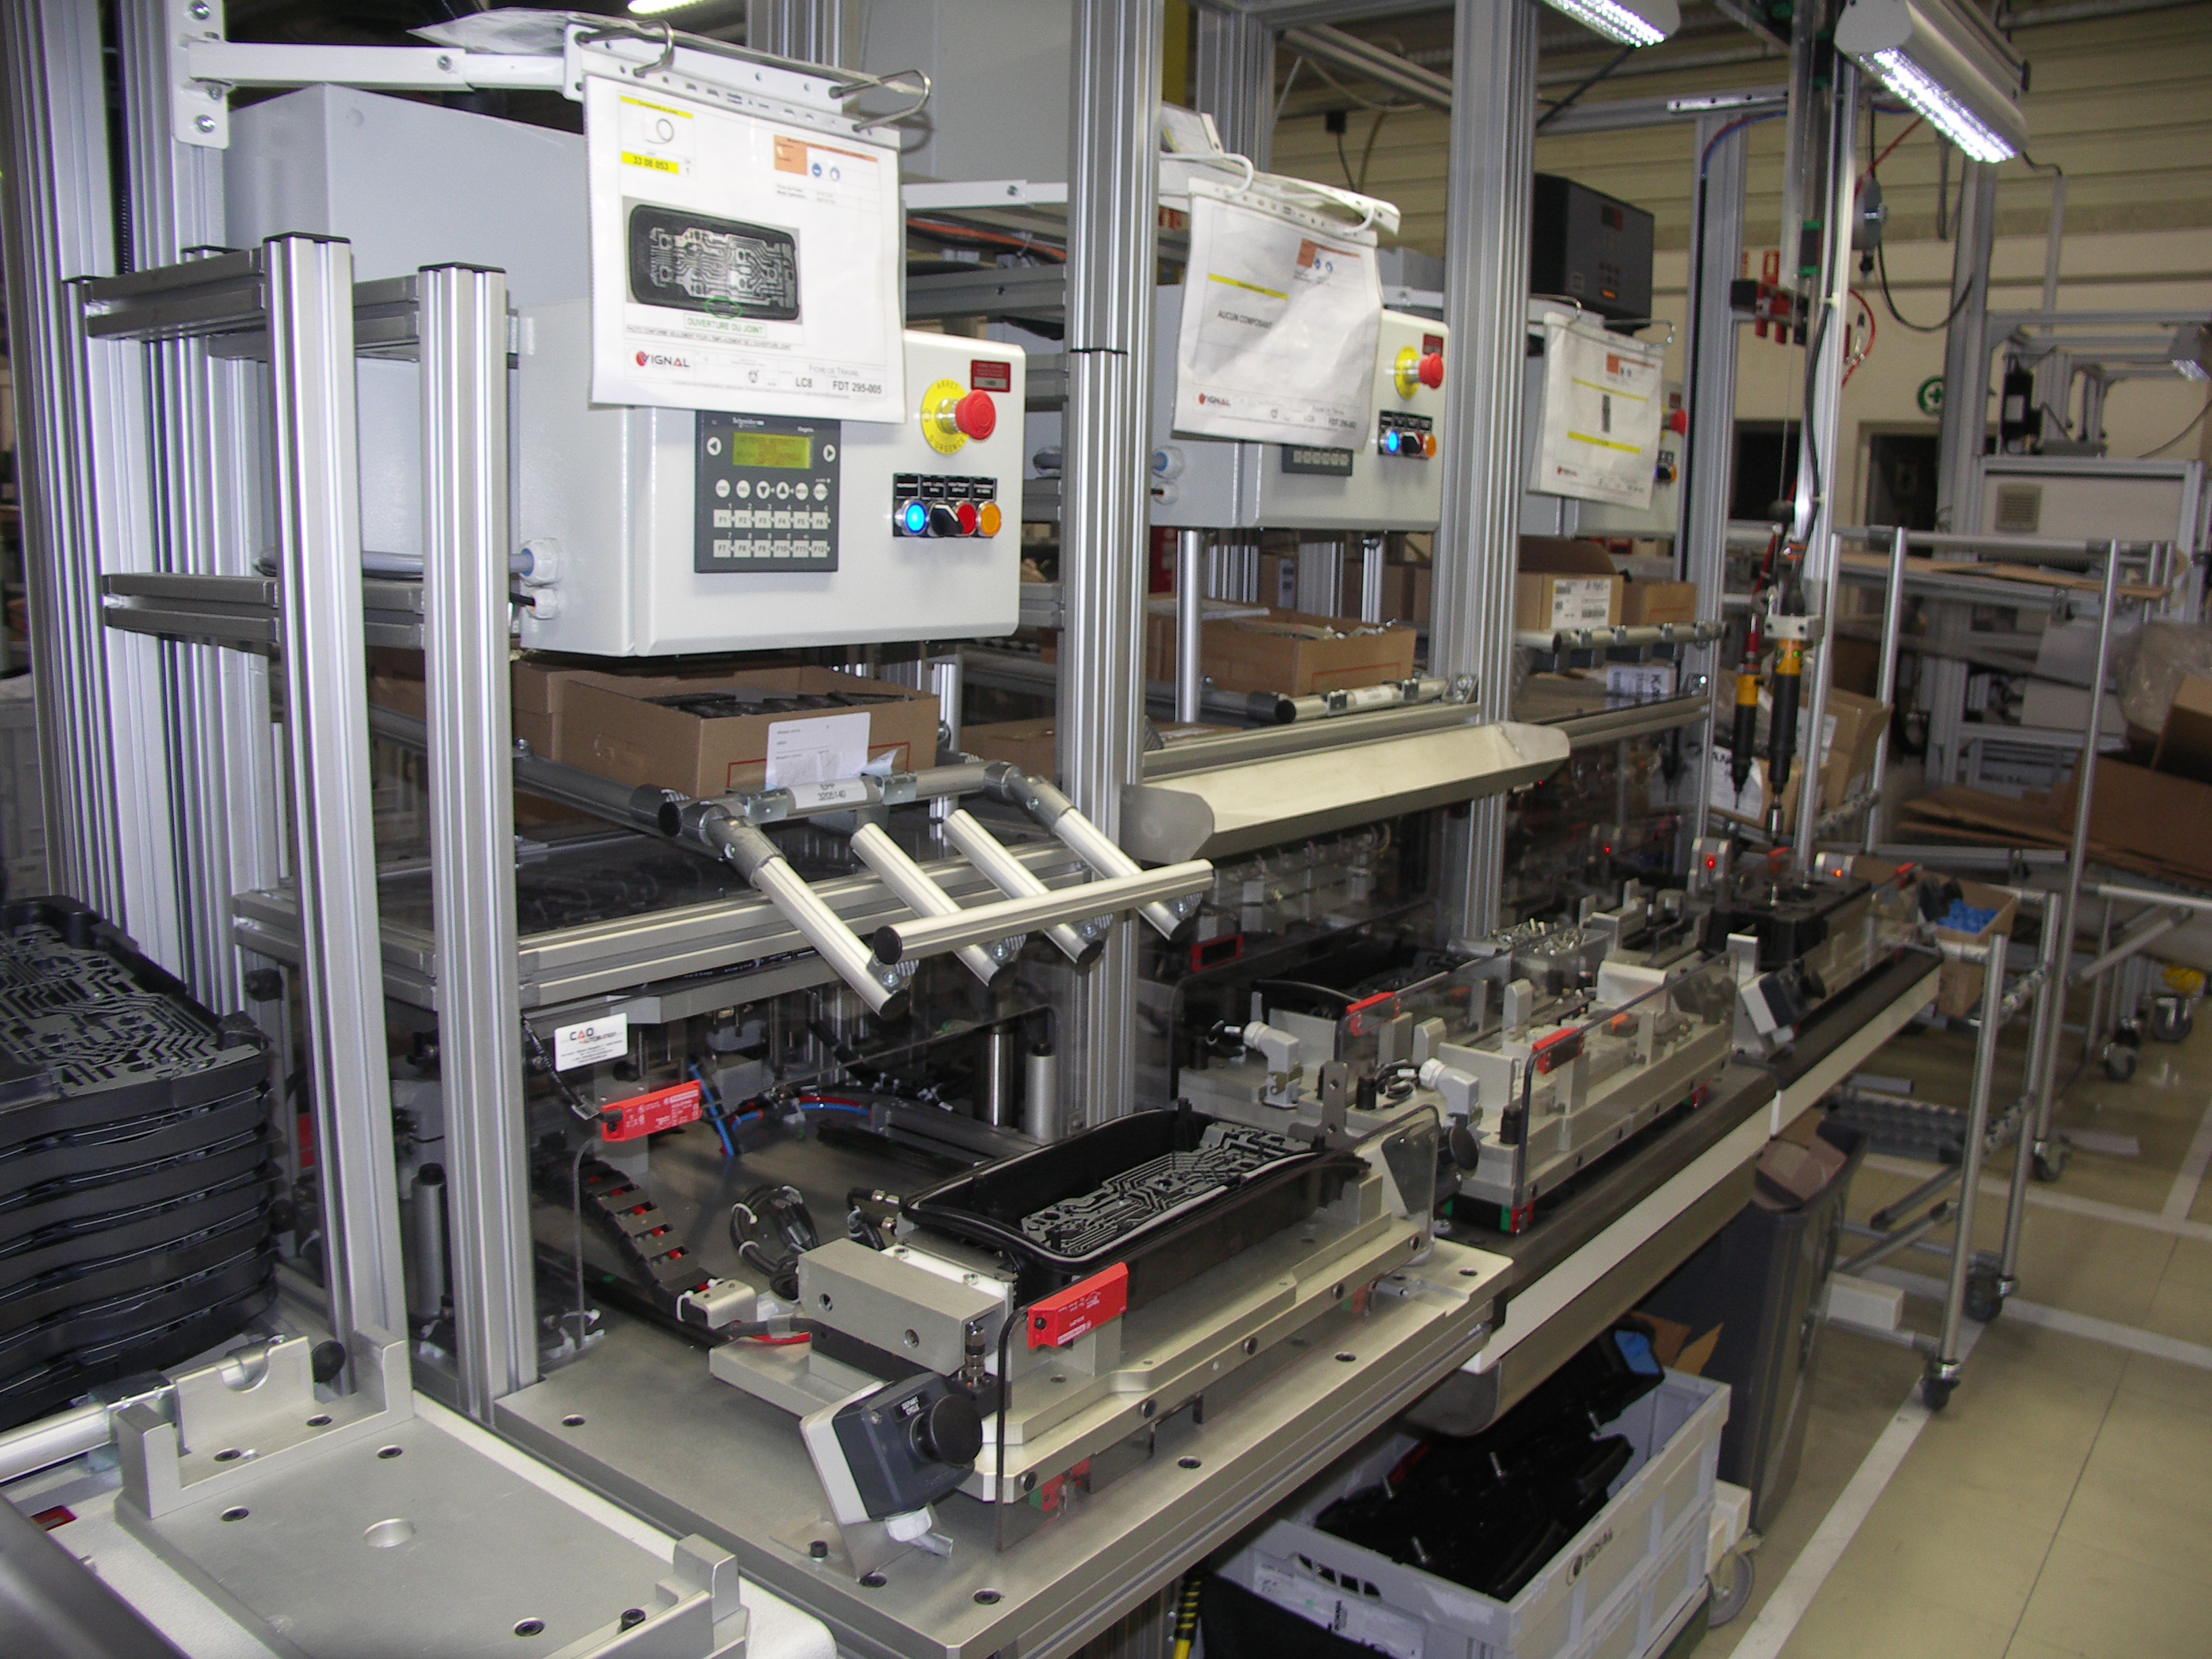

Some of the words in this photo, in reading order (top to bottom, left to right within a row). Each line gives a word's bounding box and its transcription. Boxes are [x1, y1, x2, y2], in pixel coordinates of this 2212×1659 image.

[633, 156, 642, 165] 33
[655, 161, 669, 171] 053
[687, 317, 729, 330] OUVERTURE
[731, 323, 741, 332] DU
[743, 325, 763, 334] JOINT
[796, 377, 813, 388] LC8
[833, 380, 849, 392] FDT
[852, 384, 882, 394] 295-005
[936, 380, 958, 390] ARRET
[570, 1027, 594, 1041] CAO
